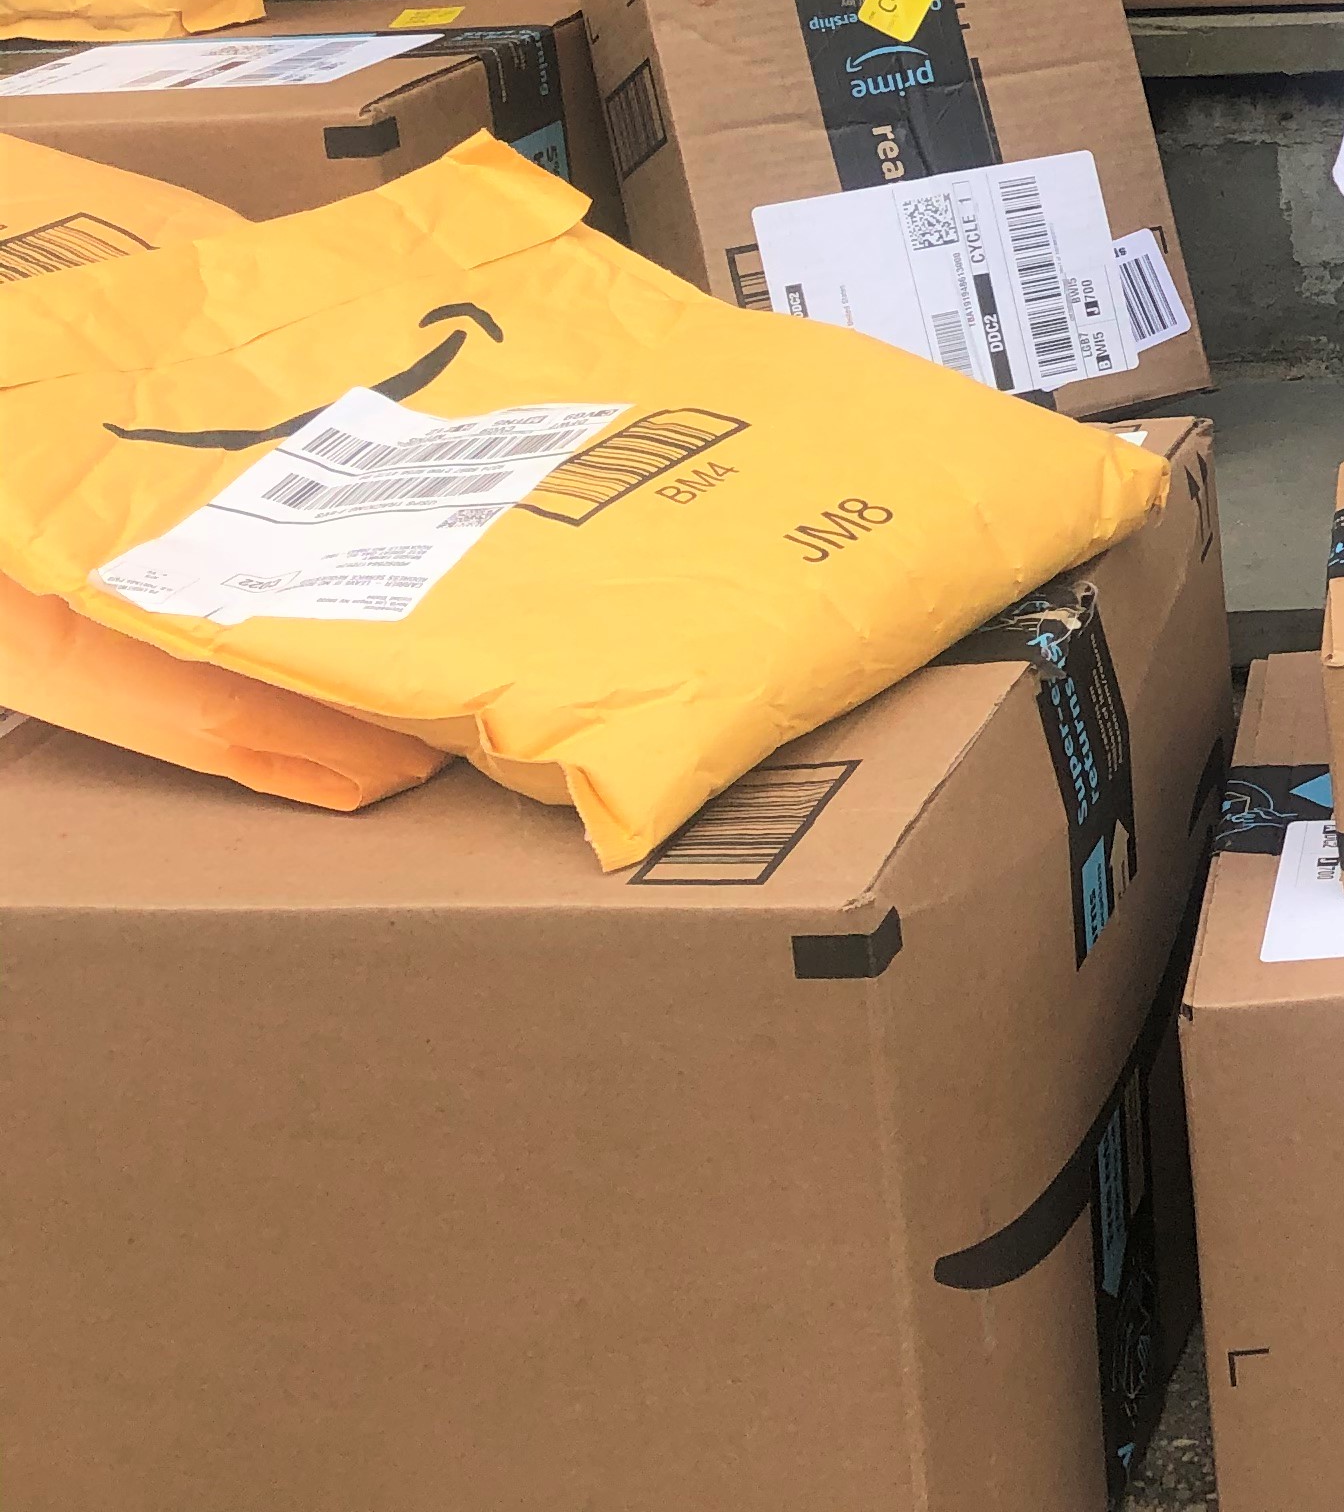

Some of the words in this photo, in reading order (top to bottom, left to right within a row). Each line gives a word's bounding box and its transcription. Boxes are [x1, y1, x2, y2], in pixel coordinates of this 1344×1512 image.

[851, 60, 936, 99] prime
[960, 215, 986, 265] CYCLE
[1081, 279, 1101, 317] J700
[984, 313, 1004, 353] DDC2
[654, 461, 740, 506] BM4
[783, 497, 895, 564] JM8
[1065, 676, 1100, 806] returns
